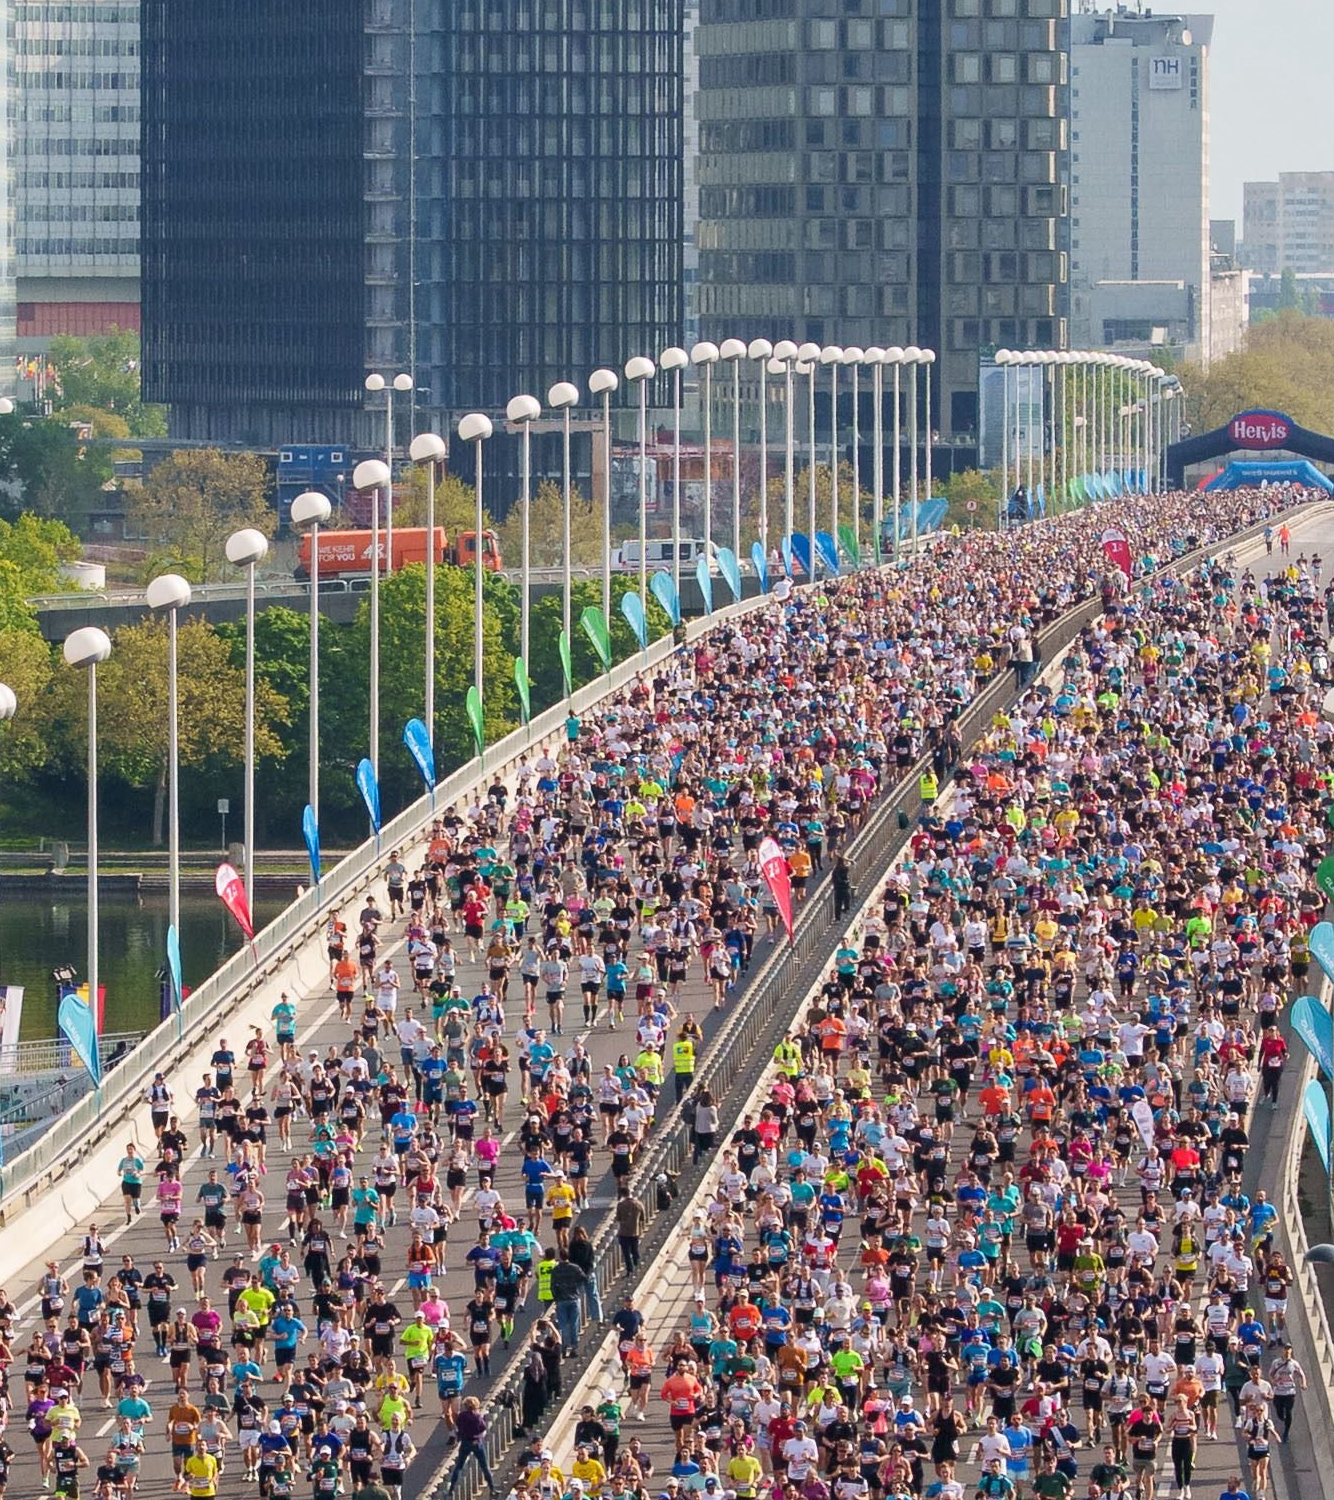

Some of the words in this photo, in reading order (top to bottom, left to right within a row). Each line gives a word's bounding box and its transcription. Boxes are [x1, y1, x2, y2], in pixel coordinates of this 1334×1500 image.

[1234, 421, 1287, 442] Hervis
[333, 545, 355, 553] KEHR
[337, 553, 355, 561] YOU
